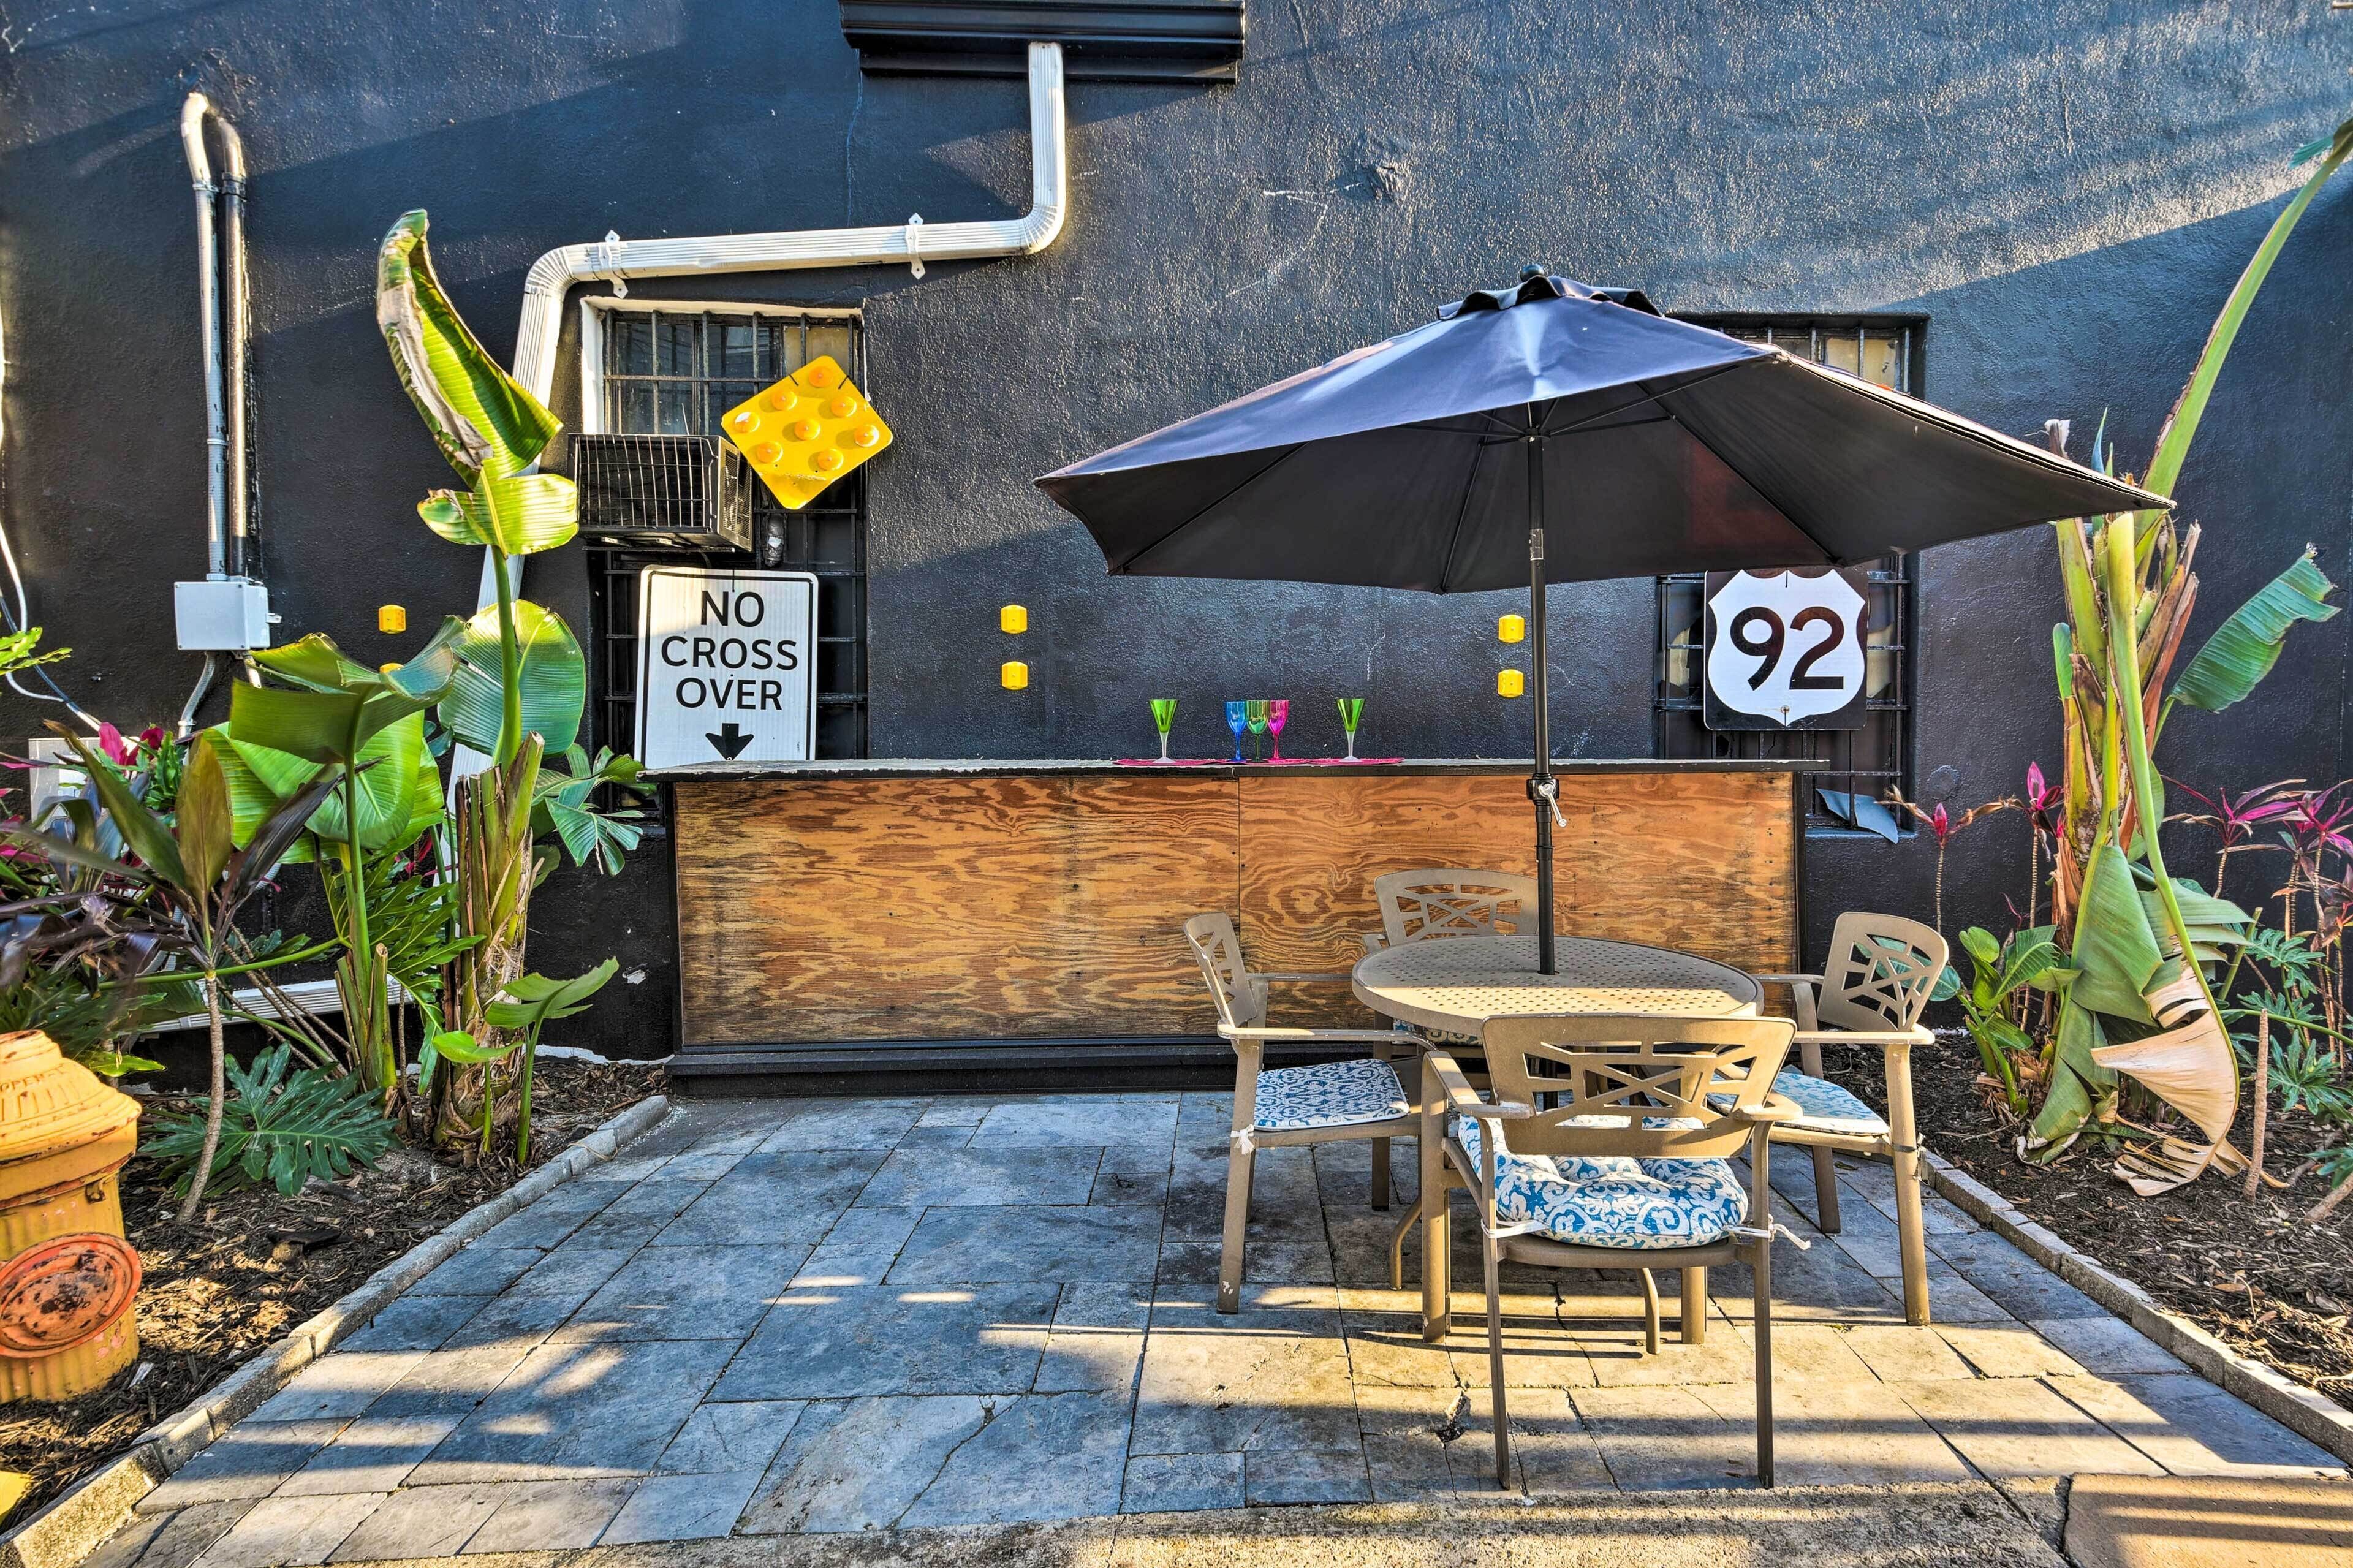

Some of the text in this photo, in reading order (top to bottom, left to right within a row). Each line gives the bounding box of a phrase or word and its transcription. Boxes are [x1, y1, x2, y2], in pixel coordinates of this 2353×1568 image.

[700, 590, 765, 627] NO
[661, 635, 798, 670] CROSS
[1730, 606, 1844, 691] 92
[676, 677, 782, 710] OVER
